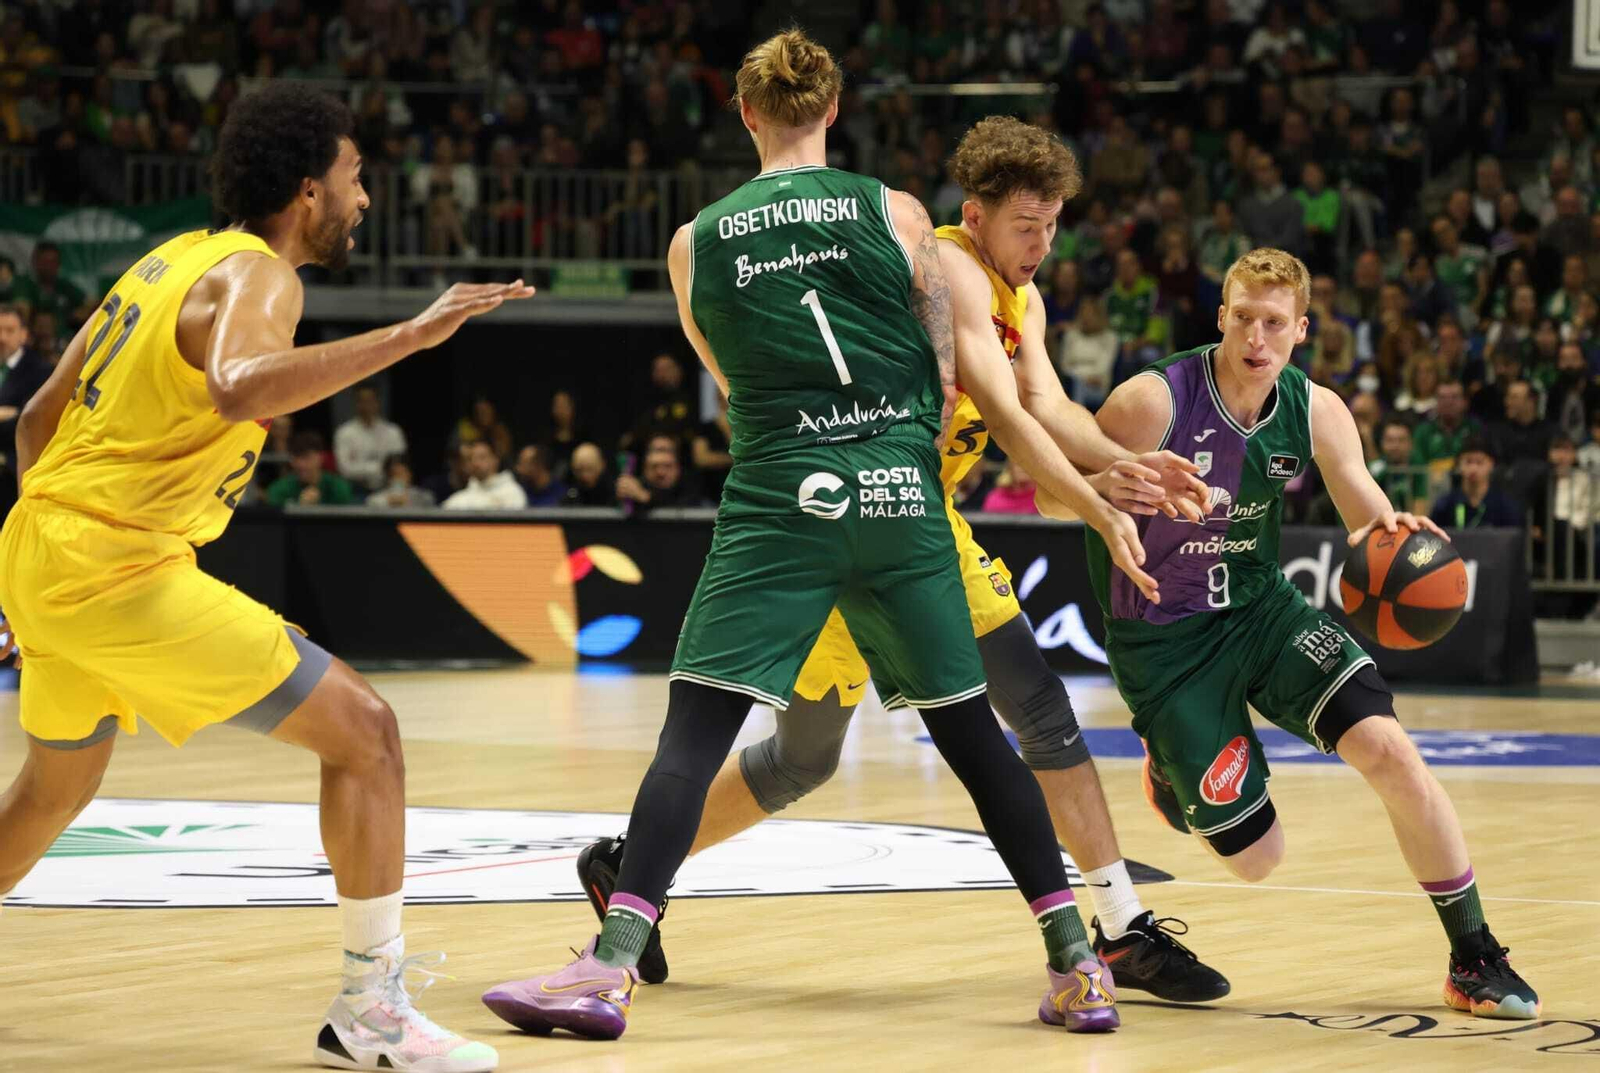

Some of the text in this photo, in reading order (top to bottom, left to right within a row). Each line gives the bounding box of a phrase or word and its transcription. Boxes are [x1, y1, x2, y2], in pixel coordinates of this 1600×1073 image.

[719, 198, 858, 240] OSETKOWSKI
[71, 292, 141, 411] 22
[800, 289, 852, 386] 1
[796, 394, 896, 435] Andalucía
[858, 466, 922, 486] COSTA
[859, 486, 926, 503] DEL SOL
[860, 502, 926, 518] MÁLAGA
[1207, 562, 1231, 608] 9
[1292, 629, 1310, 647] sabor
